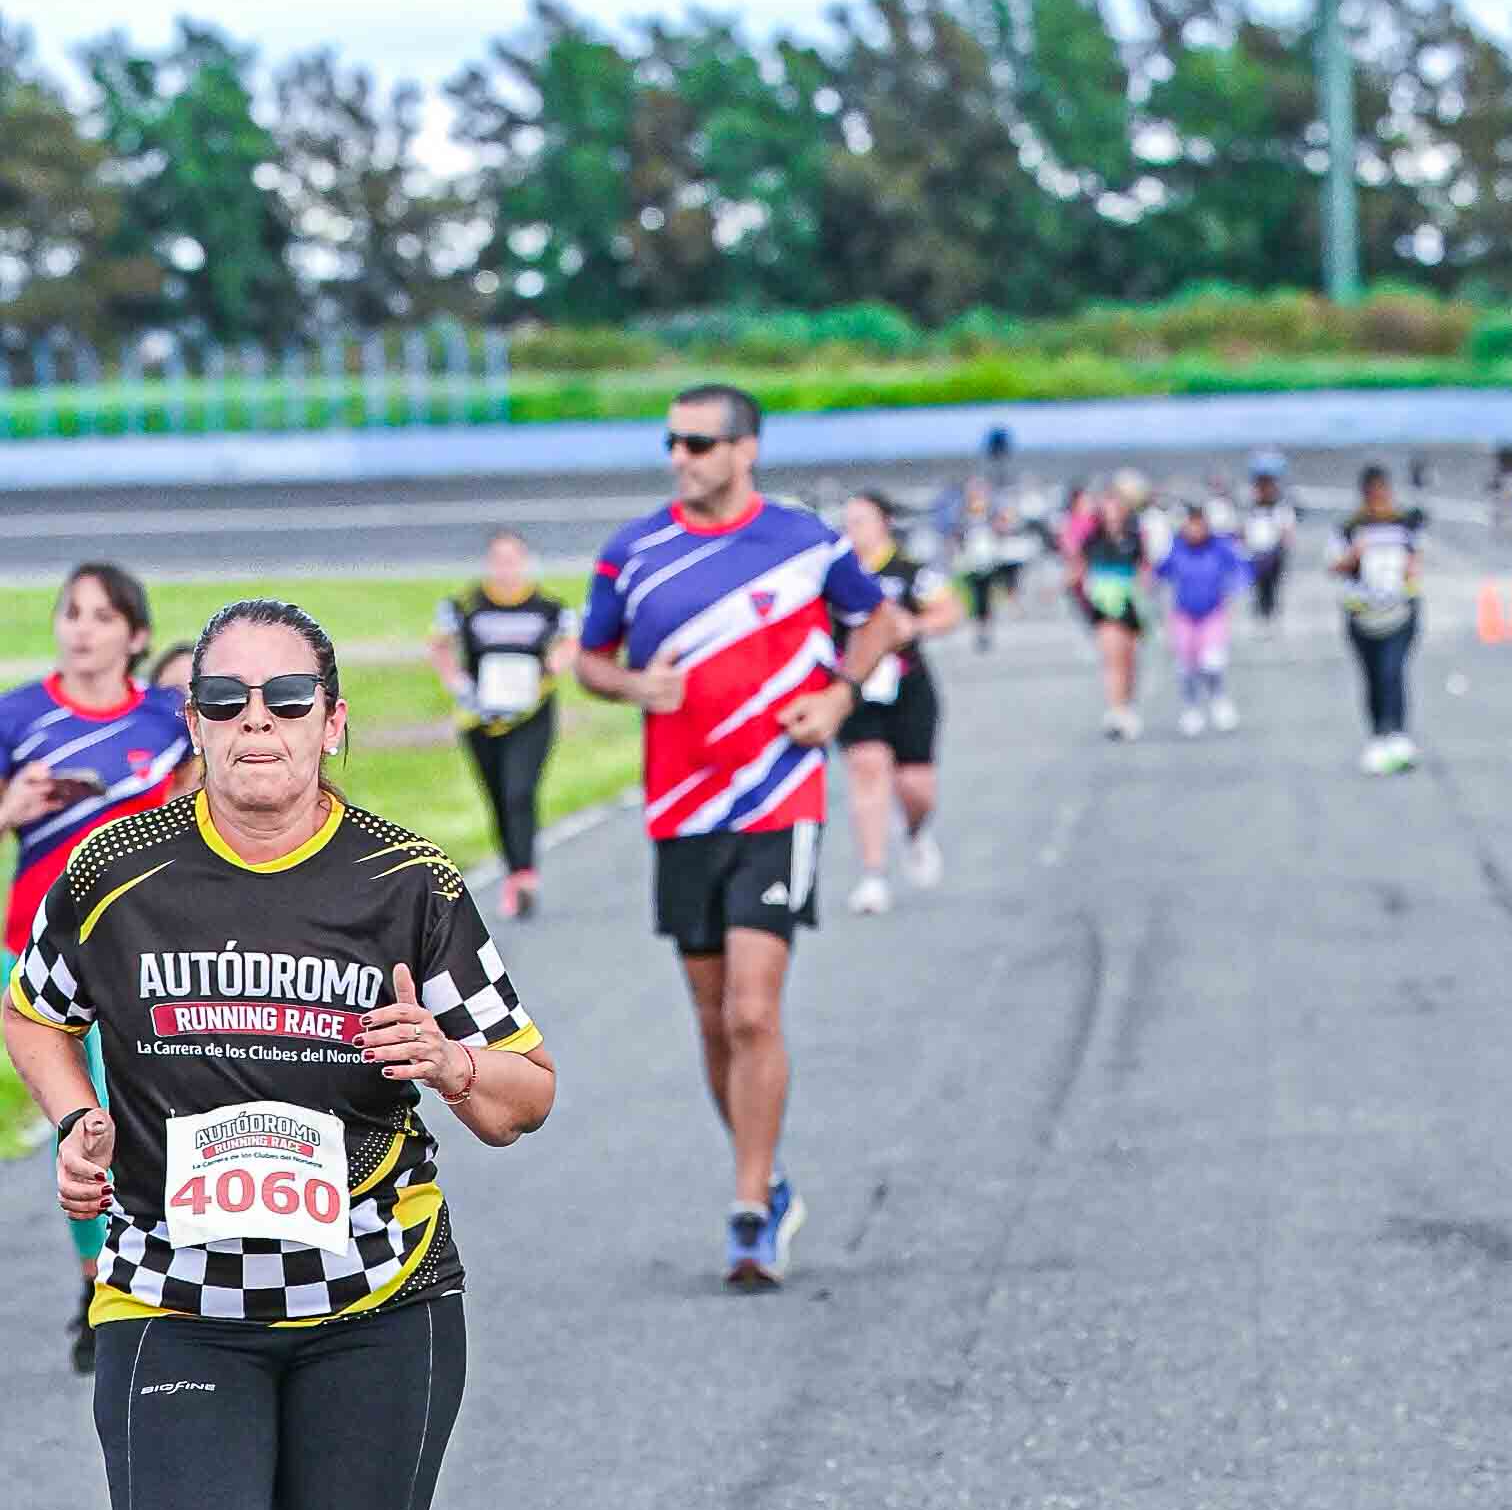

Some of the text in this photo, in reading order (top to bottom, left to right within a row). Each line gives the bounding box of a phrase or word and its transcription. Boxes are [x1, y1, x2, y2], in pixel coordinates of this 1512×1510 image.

[139, 940, 385, 1009] AUTÓDROMO
[174, 1005, 345, 1040] RUNNING RACE
[136, 1039, 152, 1054] La
[153, 1040, 203, 1056] Carrera
[204, 1042, 224, 1058] de
[225, 1043, 247, 1059] los
[248, 1045, 299, 1062] Clubes
[300, 1047, 324, 1063] del
[195, 1111, 321, 1149] AUTÓDROMO
[214, 1135, 303, 1155] RUNNING RACE
[170, 1169, 341, 1223] 4060
